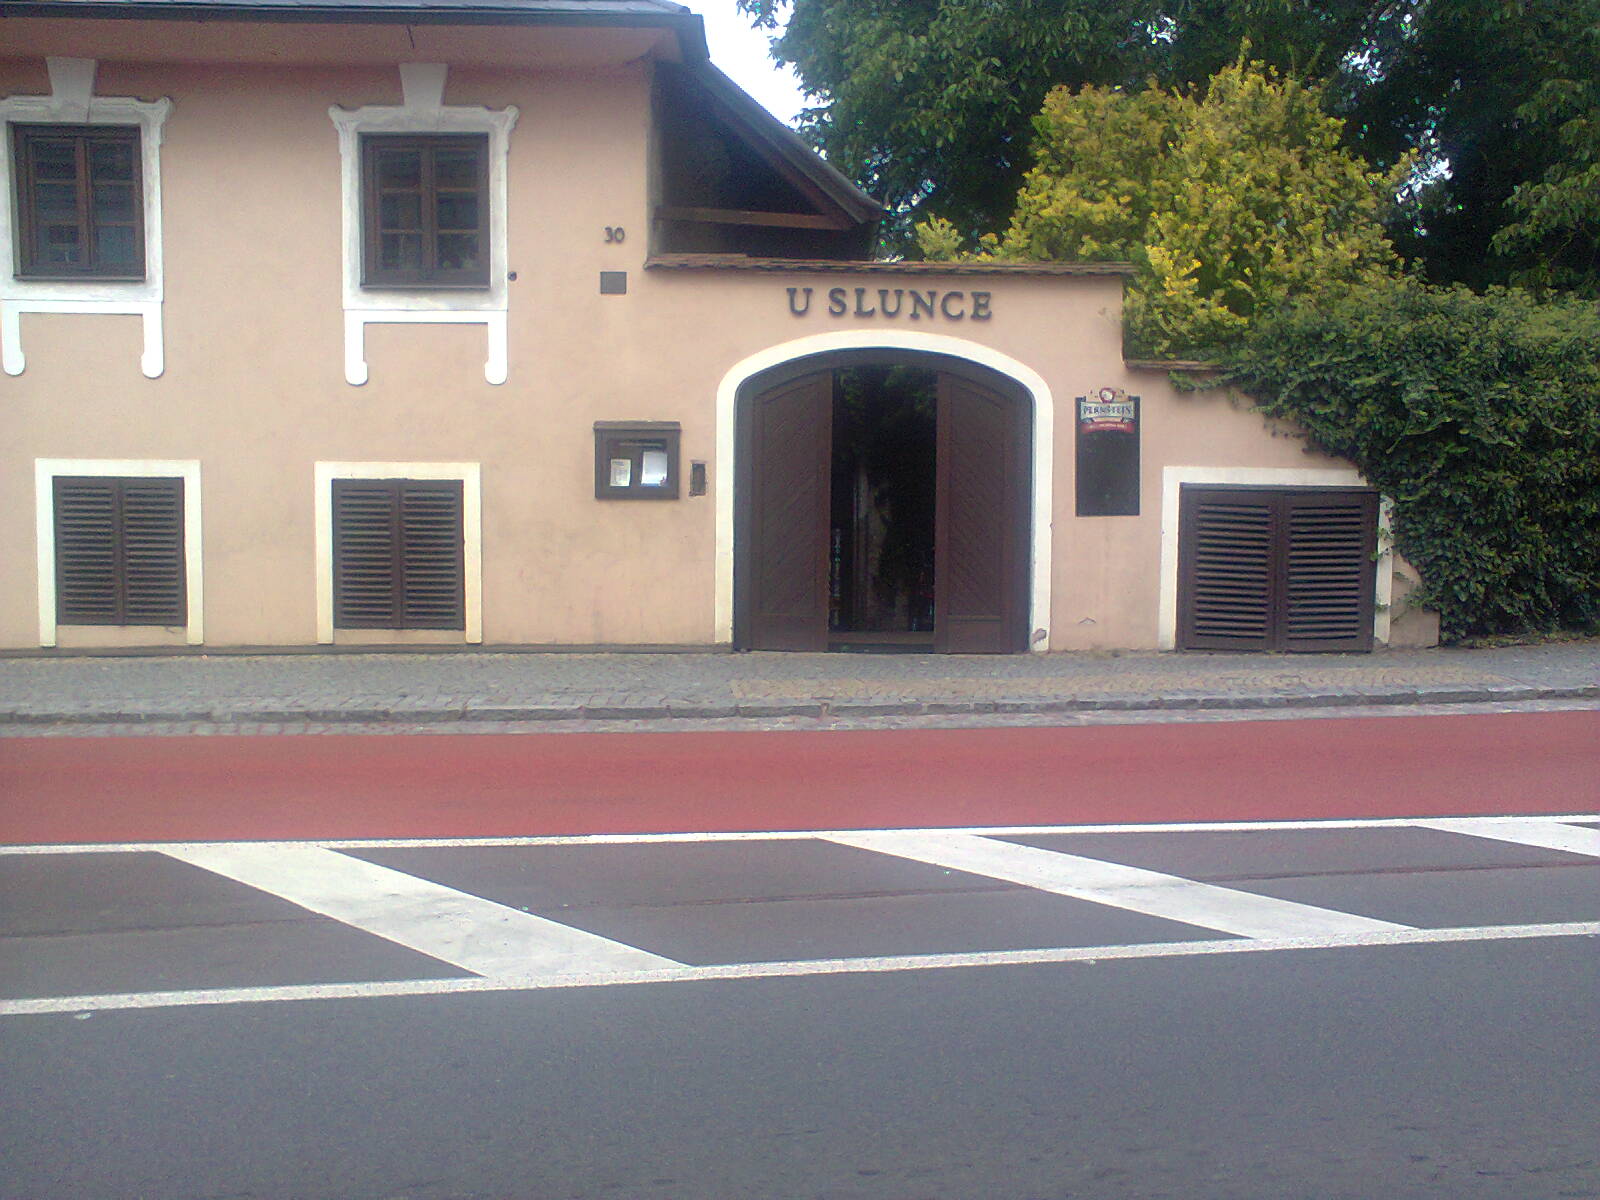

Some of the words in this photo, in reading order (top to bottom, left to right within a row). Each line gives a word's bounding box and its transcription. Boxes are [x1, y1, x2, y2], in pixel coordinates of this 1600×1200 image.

[604, 226, 625, 244] 30
[786, 287, 813, 316] U
[828, 287, 993, 321] SLUNCE
